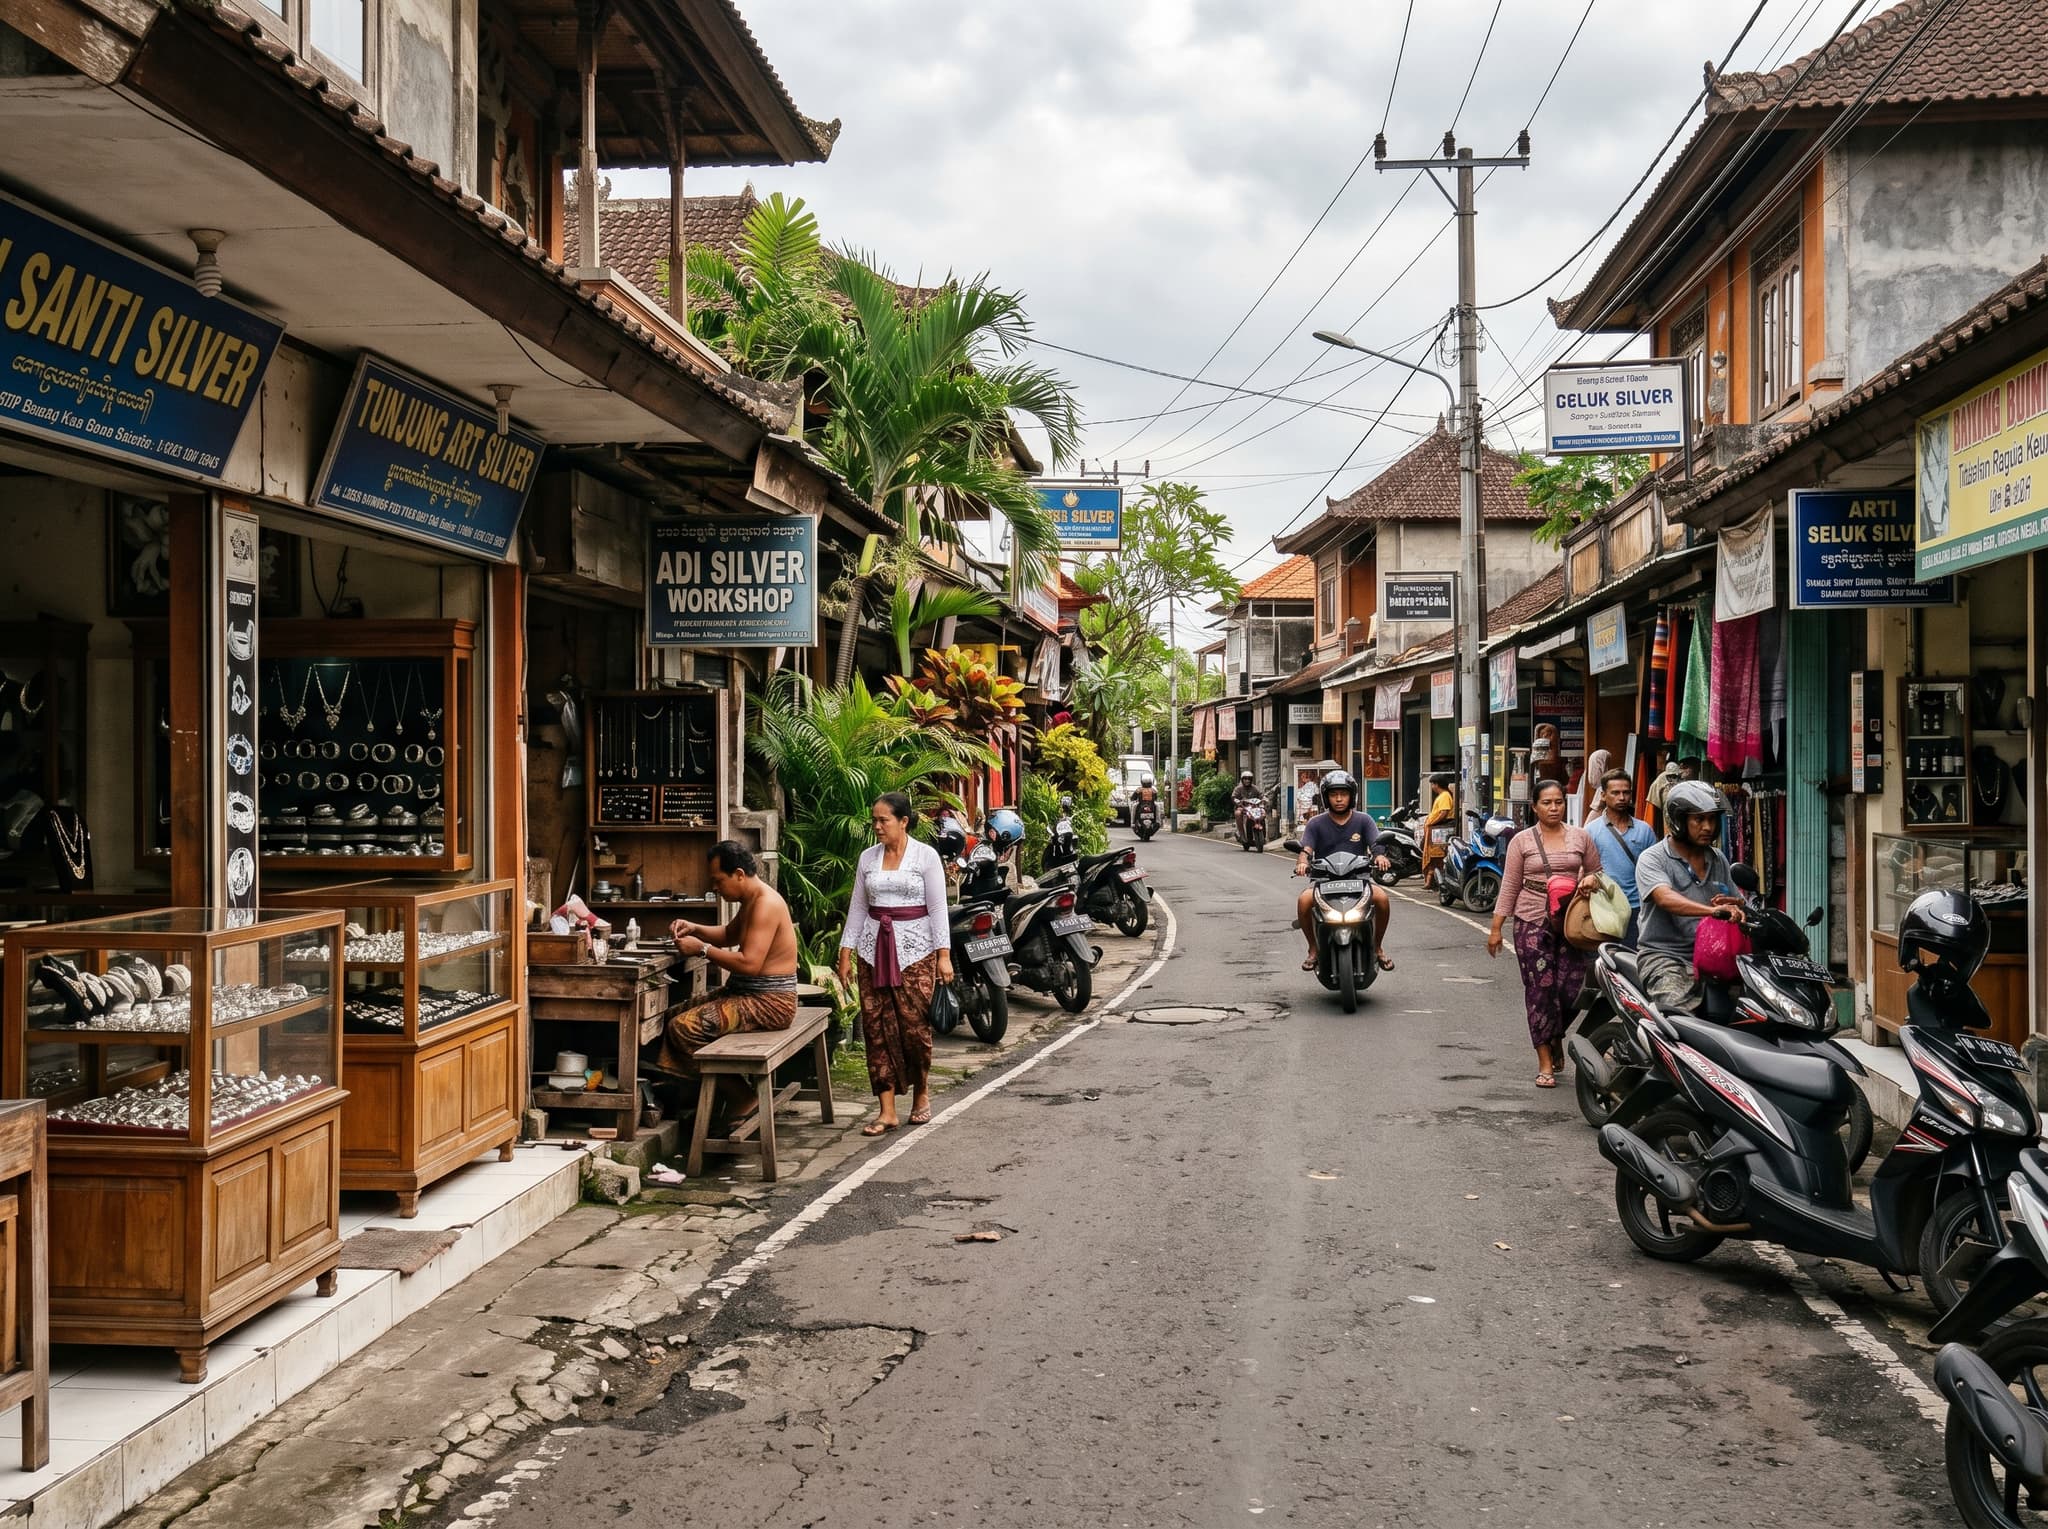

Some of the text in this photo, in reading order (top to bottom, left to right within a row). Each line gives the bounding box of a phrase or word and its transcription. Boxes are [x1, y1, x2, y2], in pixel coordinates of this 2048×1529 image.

[5, 252, 144, 366] SANTI
[135, 306, 259, 409] SILVER
[1556, 389, 1673, 408] GELUK SILVER
[358, 378, 448, 457] TUNJUNG
[442, 418, 485, 471] ART
[479, 432, 535, 492] SILVER
[1071, 510, 1115, 523] SILVER
[1849, 500, 1896, 518] ARTI
[1808, 524, 1915, 543] SELUK SILV
[656, 551, 806, 584] ADI SILVER
[668, 588, 793, 613] WORKSHOP
